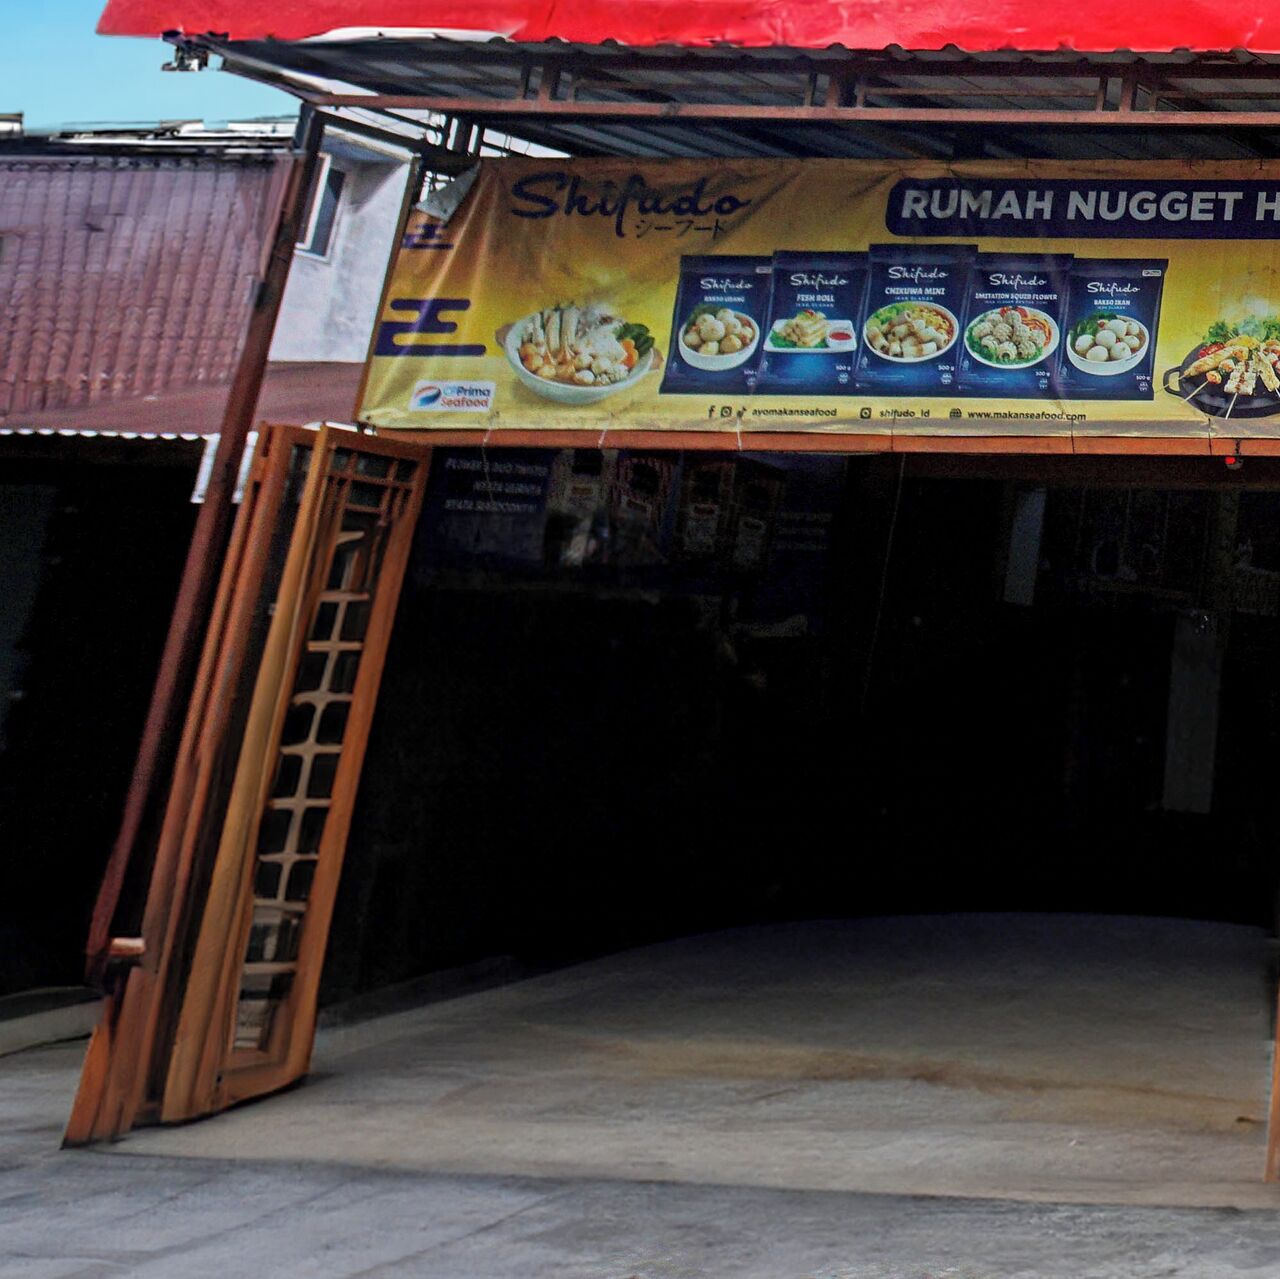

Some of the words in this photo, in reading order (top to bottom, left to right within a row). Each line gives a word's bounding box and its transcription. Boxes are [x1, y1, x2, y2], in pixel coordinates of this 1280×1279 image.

[512, 171, 751, 237] Shifudo
[901, 189, 1052, 221] RUMAH
[1067, 190, 1241, 222] NUGGET
[790, 273, 849, 291] Shifudo
[888, 266, 949, 284] Shifudo
[989, 273, 1047, 290] Shifudo
[700, 277, 753, 293] Shifudo
[885, 287, 922, 295] CHIKUWA
[924, 287, 946, 295] MINI
[1087, 281, 1140, 297] Shifudo
[440, 397, 489, 408] Seafood
[752, 406, 837, 417] ayomakanseafood
[967, 410, 1087, 422] www.makanseafood.com
